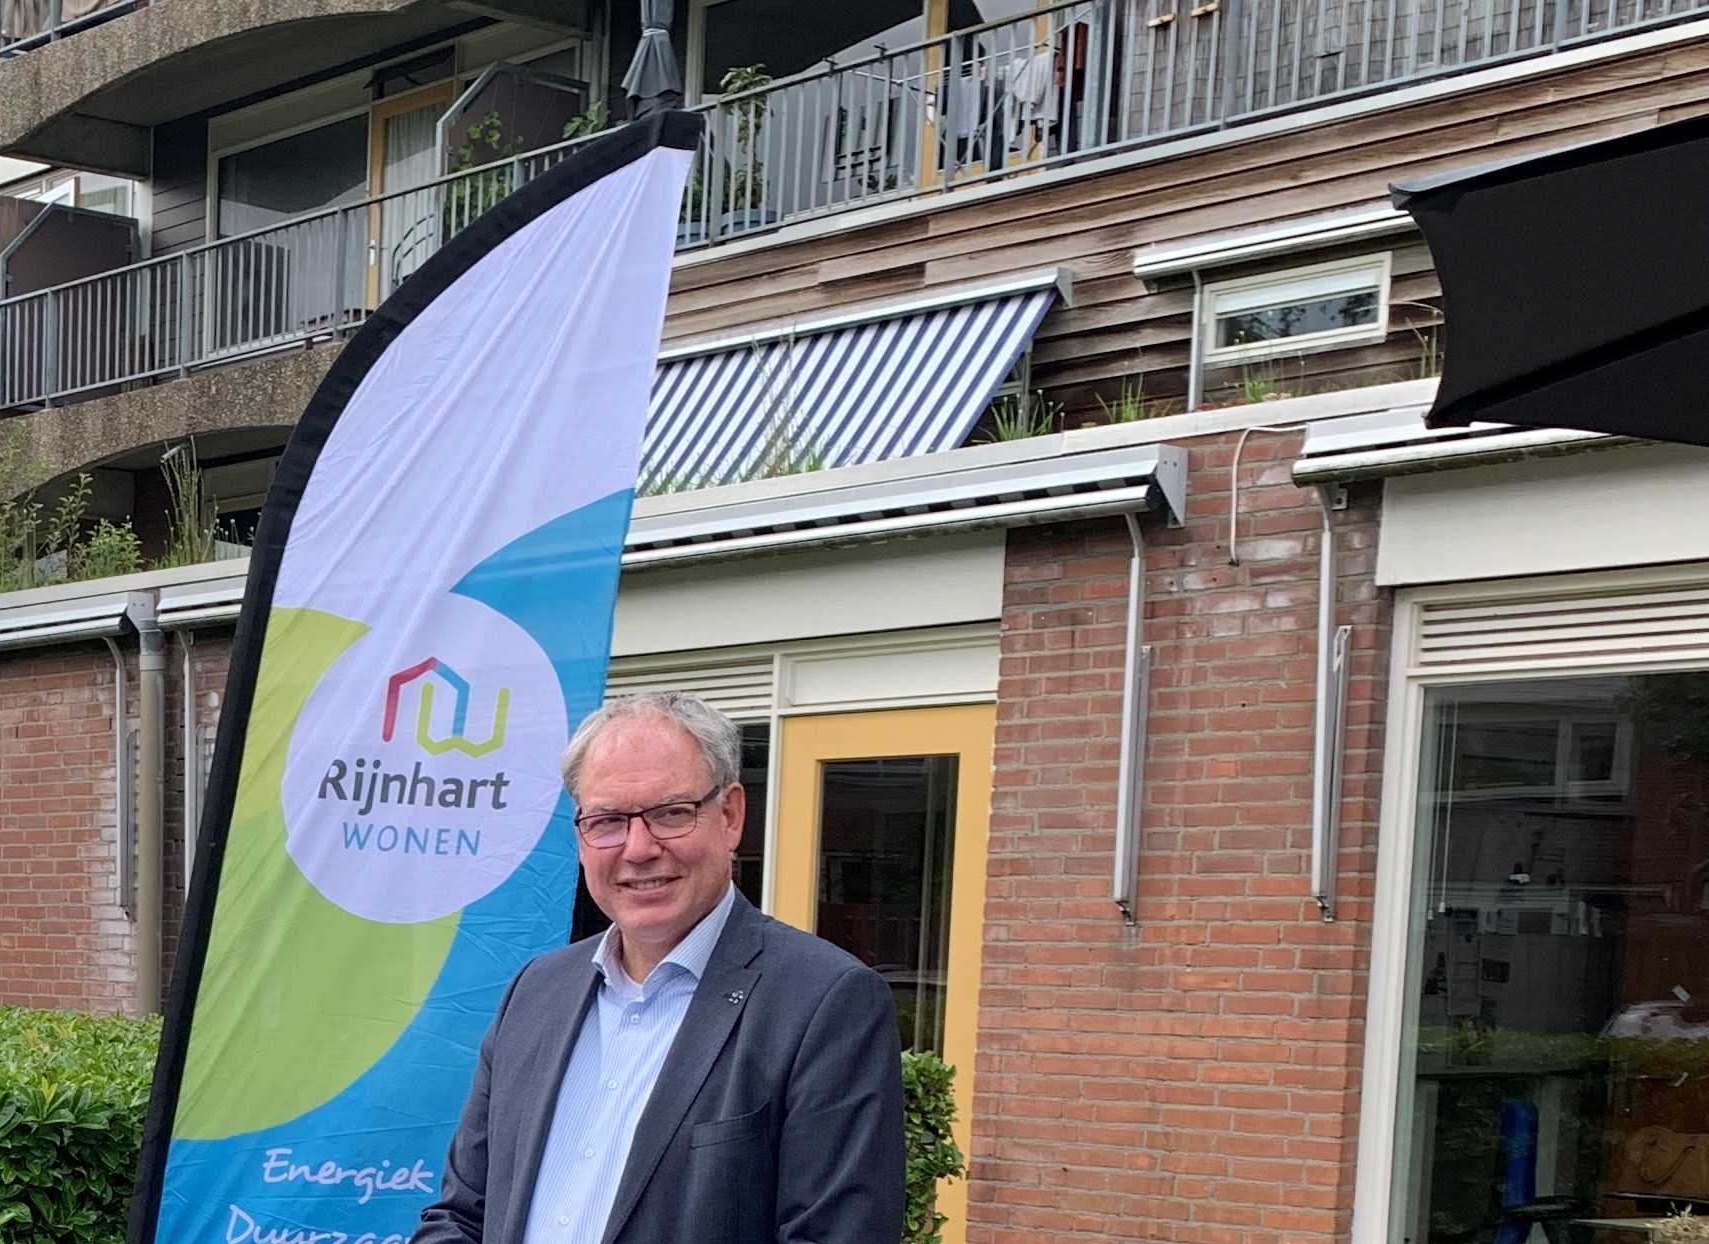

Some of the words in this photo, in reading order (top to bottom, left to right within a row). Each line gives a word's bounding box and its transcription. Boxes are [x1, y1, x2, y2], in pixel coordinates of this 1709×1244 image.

[318, 757, 511, 816] Rijnhart
[343, 821, 481, 857] WONEN
[262, 1148, 435, 1205] Energiek
